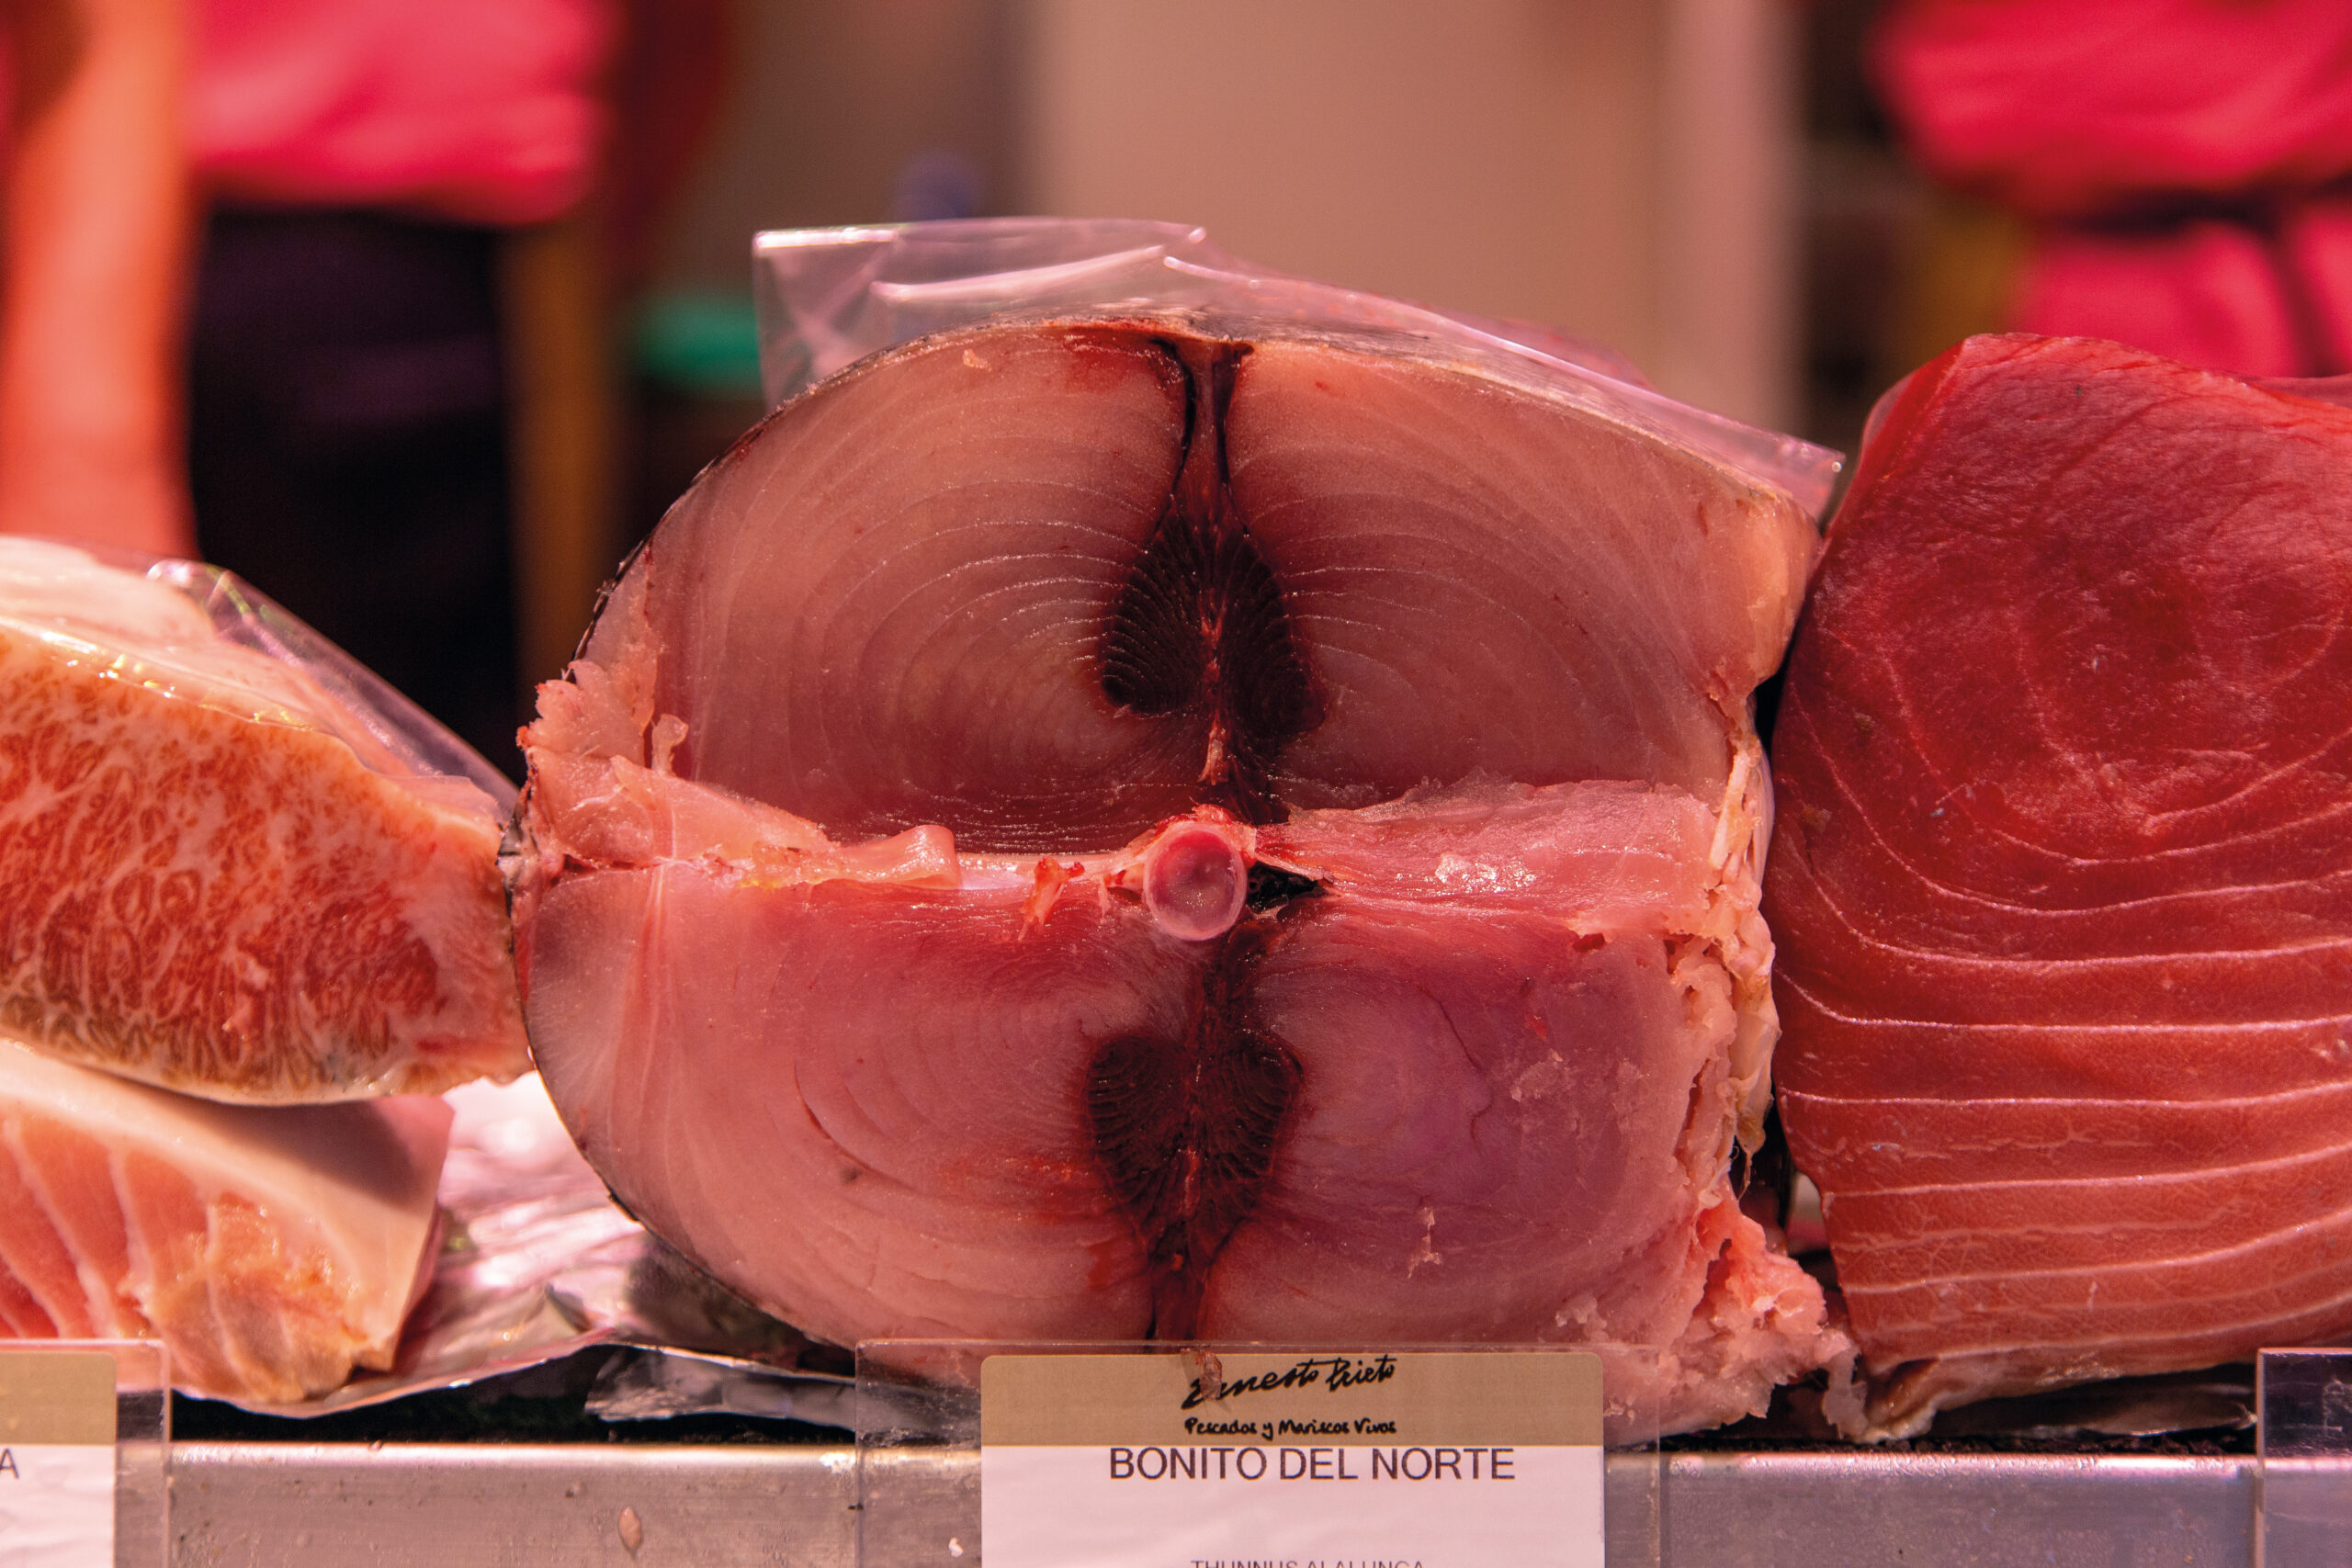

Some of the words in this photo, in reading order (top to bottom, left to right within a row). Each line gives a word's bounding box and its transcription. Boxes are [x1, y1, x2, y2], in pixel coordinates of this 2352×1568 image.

[1325, 1354, 1397, 1393] Prieto
[1184, 1416, 1258, 1435] Pescados
[1261, 1422, 1274, 1441] y
[1278, 1419, 1351, 1435] Mariscos
[1354, 1417, 1397, 1434] Vivos
[1110, 1447, 1268, 1480] BONITO
[1280, 1448, 1359, 1480] DEL
[1373, 1447, 1515, 1480] NORTE
